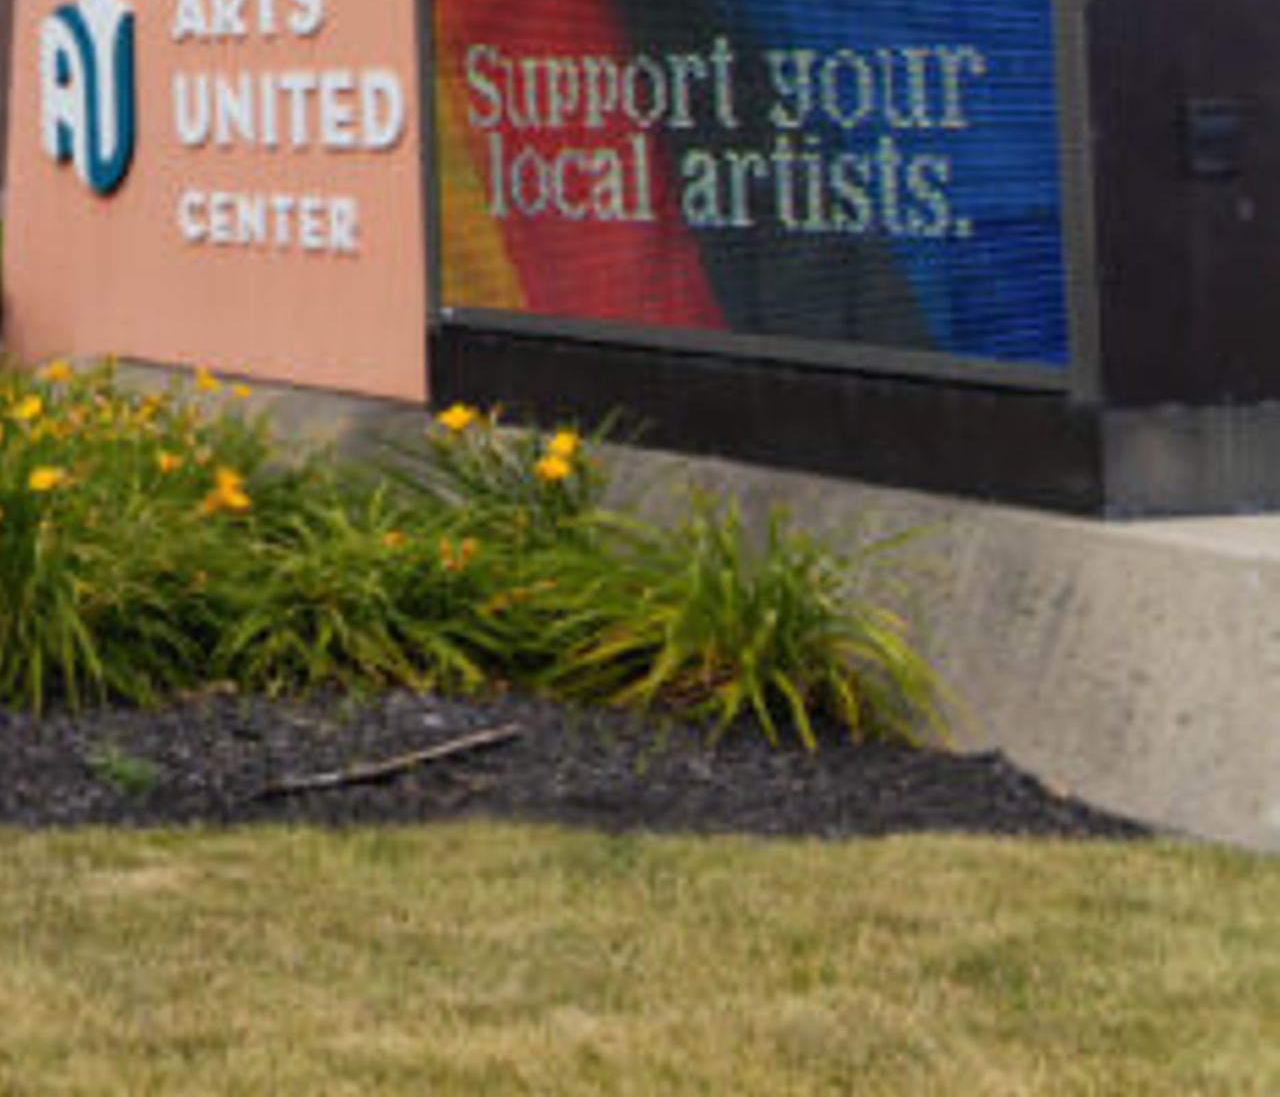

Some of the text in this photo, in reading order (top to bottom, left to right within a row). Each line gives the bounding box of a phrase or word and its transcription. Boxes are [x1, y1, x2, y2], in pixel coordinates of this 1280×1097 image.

[172, 69, 404, 151] UNITED
[465, 36, 988, 129] Support your
[178, 190, 359, 252] CENTER
[488, 131, 975, 237] local artists.
